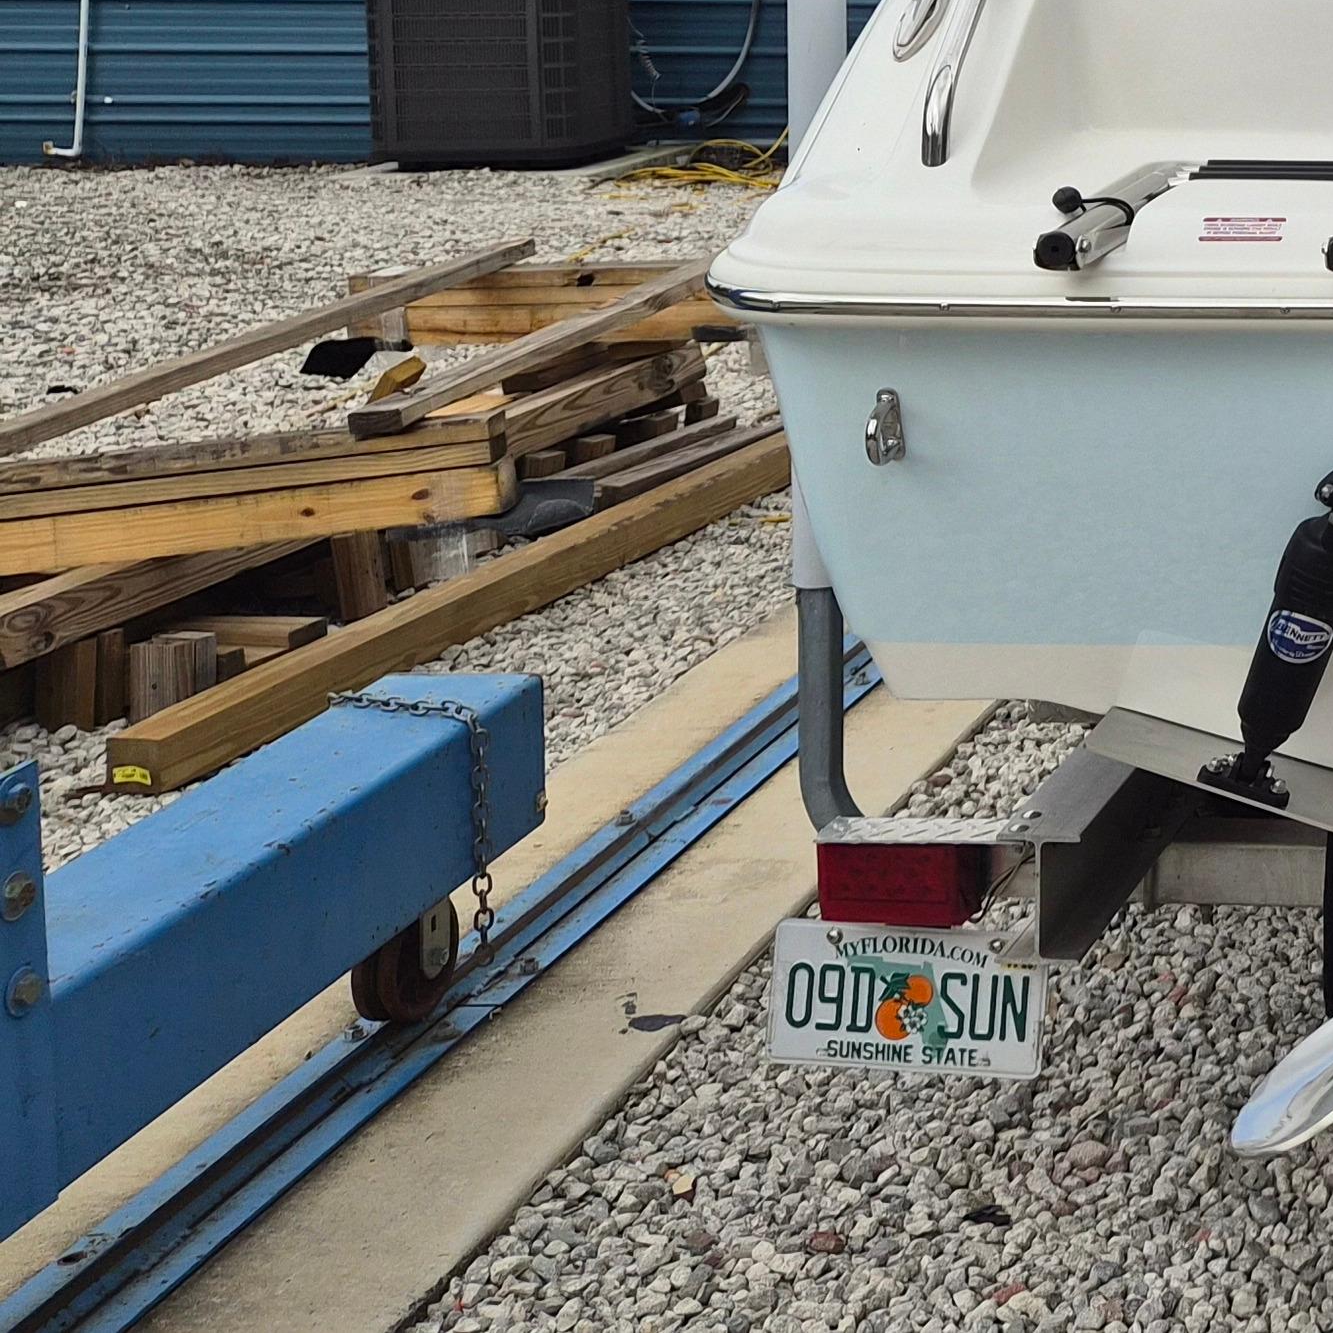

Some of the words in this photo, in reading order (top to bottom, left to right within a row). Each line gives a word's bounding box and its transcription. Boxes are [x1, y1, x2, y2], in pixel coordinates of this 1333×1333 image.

[835, 936, 988, 968] MYFLORIDA.COM
[785, 962, 875, 1033] 09D
[937, 972, 1030, 1043] SUN
[826, 1040, 913, 1064] SUNSHINE
[922, 1047, 978, 1067] STATE
